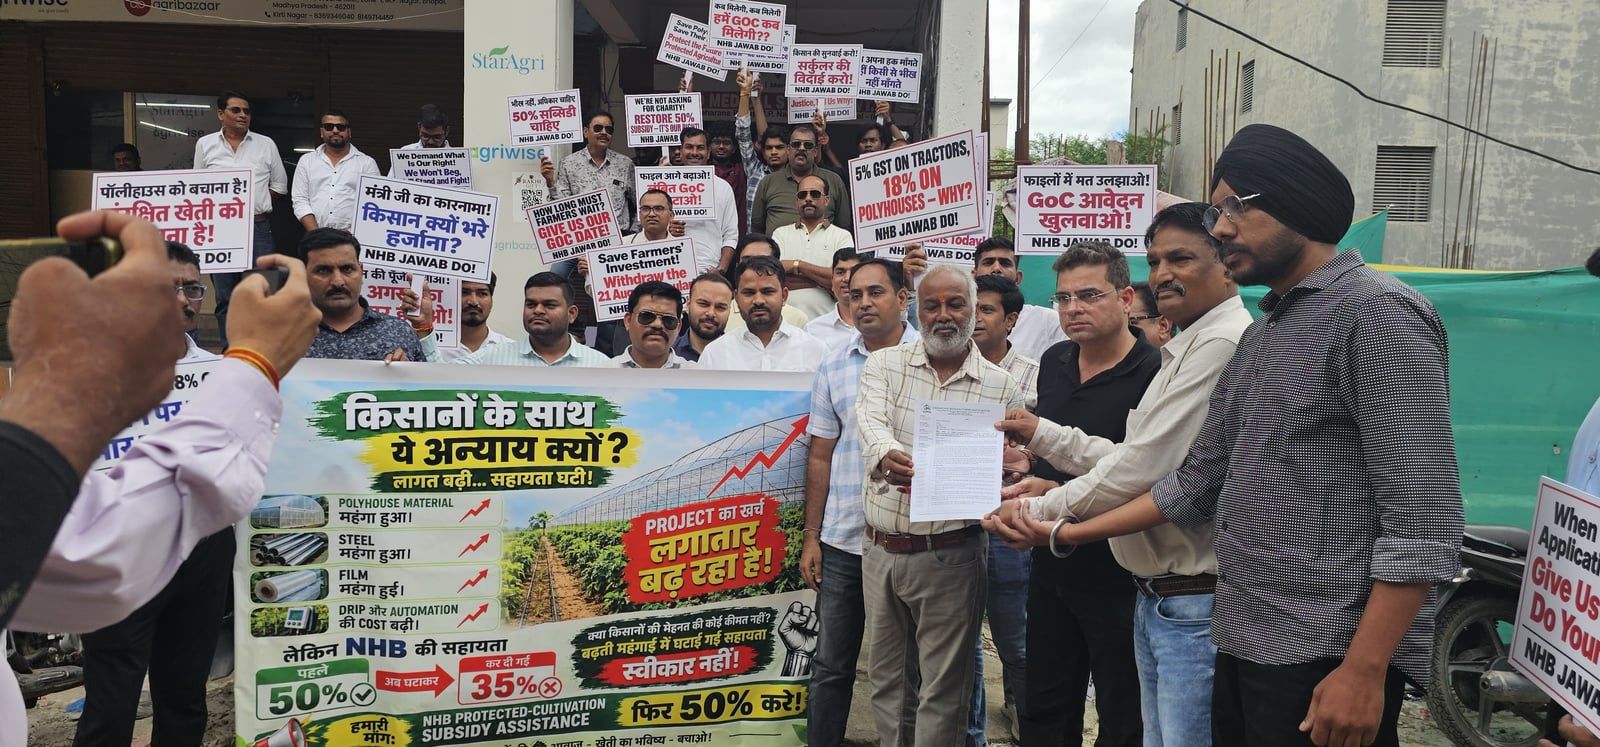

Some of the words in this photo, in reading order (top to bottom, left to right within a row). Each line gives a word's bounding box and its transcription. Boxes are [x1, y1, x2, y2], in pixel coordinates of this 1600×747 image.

[673, 26, 689, 37] Save
[676, 19, 692, 29] Save
[713, 12, 731, 24] हमें
[732, 16, 759, 27] GOC
[761, 19, 781, 30] कब
[664, 41, 694, 56] Protected
[667, 33, 692, 46] Protect
[692, 39, 702, 49] the
[701, 43, 722, 56] Future
[717, 40, 733, 48] NHB
[733, 42, 760, 50] JAWAB
[760, 44, 774, 53] DO!
[472, 52, 545, 75] StarAgri
[665, 53, 681, 64] NHB
[681, 56, 706, 71] JAWAB
[706, 65, 720, 76] DO!
[835, 59, 850, 71] की
[868, 66, 889, 76] किसी
[889, 67, 897, 77] से
[899, 69, 917, 79] भीख
[794, 72, 826, 84] विदाई
[828, 73, 852, 84] करो!
[865, 77, 880, 87] नहीं
[512, 109, 538, 122] 50%
[540, 104, 577, 119] सब्सिडी
[634, 114, 673, 125] RESTORE
[674, 112, 695, 123] 50%
[655, 104, 685, 112] CHARITY!
[529, 120, 561, 132] चाहिए
[630, 124, 653, 134] SUBSIDY
[670, 124, 682, 132] OUR
[535, 133, 560, 142] JAWAB
[655, 135, 680, 143] JAWAB
[411, 152, 443, 160] Demand
[432, 159, 456, 167] Right!
[855, 163, 872, 181] 5%
[873, 158, 893, 178] GST
[895, 155, 910, 172] ON
[910, 140, 970, 168] TRACTORS,
[444, 169, 462, 177] Beg,
[450, 177, 470, 185] Fight!
[640, 172, 663, 181] फाइल
[664, 170, 681, 180] आगे
[882, 171, 917, 199] 18%
[919, 165, 942, 191] ON
[1023, 171, 1062, 188] फाइलों
[1063, 171, 1074, 186] में
[1075, 174, 1093, 186] मत
[1096, 171, 1150, 188] उलझाओ!
[100, 182, 165, 199] पॉलीहाउस
[168, 180, 186, 196] को
[188, 182, 229, 196] बचाना
[232, 178, 248, 194] है!
[678, 182, 705, 193] GoC
[174, 197, 216, 222] खेती
[219, 196, 246, 220] को
[533, 204, 553, 218] HOW
[553, 199, 577, 215] LONG
[578, 193, 602, 210] MUST
[858, 192, 925, 224] POLYHOUSES
[937, 181, 973, 206] WHY?
[1027, 191, 1075, 209] GoC
[1079, 187, 1145, 210] आवेदन
[362, 201, 422, 229] किसान
[425, 213, 459, 234] क्यों
[461, 217, 490, 239] भरे
[538, 221, 565, 240] GIVE
[567, 218, 585, 234] US
[586, 211, 611, 229] OUR
[874, 227, 897, 242] NHB
[898, 216, 938, 238] JAWAB
[939, 212, 959, 229] DO!
[547, 233, 576, 251] GOC
[576, 224, 611, 245] DATE!
[1032, 237, 1060, 248] NHB
[205, 252, 232, 265] DO!
[365, 248, 395, 263] NHB
[398, 253, 448, 270] JAWAB
[451, 262, 476, 275] DO!
[597, 251, 629, 264] Save
[630, 242, 684, 261] Farmers'
[605, 254, 680, 275] Investment!
[603, 269, 665, 289] Withdraw
[665, 267, 687, 281] the
[343, 392, 479, 432] किसानों
[482, 393, 518, 430] के
[523, 400, 596, 430] साथ
[390, 434, 416, 464] ये
[423, 436, 538, 466] अन्याय
[338, 497, 400, 509] POLYHOUSE
[403, 497, 454, 508] MATERIAL
[645, 507, 715, 536] PROJECT
[718, 504, 736, 521] का
[739, 498, 766, 518] खर्च
[1553, 501, 1598, 543] When
[338, 534, 375, 546] STEEL
[649, 520, 760, 564] लगातार
[338, 569, 369, 581] FILM
[636, 562, 686, 599] बढ़
[690, 553, 739, 586] रहा
[742, 546, 773, 579] है!
[1531, 556, 1573, 602] Give
[1575, 578, 1600, 621] Us
[338, 604, 366, 616] DRIP
[369, 604, 388, 617] और
[390, 603, 459, 617] AUTOMATION
[282, 641, 339, 664] लेकिन
[345, 637, 408, 659] NHB
[414, 638, 438, 657] की
[441, 638, 509, 656] सहायता
[1524, 637, 1556, 678] NHB
[621, 655, 697, 683] स्वीकार
[698, 645, 740, 674] नहीं!
[471, 670, 538, 701] 35%
[268, 681, 349, 716] 50%
[631, 699, 673, 724] फिर
[679, 689, 754, 722] 50%
[760, 687, 803, 713] करे!
[422, 713, 452, 727] NHB
[455, 697, 607, 725] PROTECTED-CULTIVATION
[422, 722, 491, 743] SUBSIDY
[496, 711, 591, 736] ASSISTANCE
